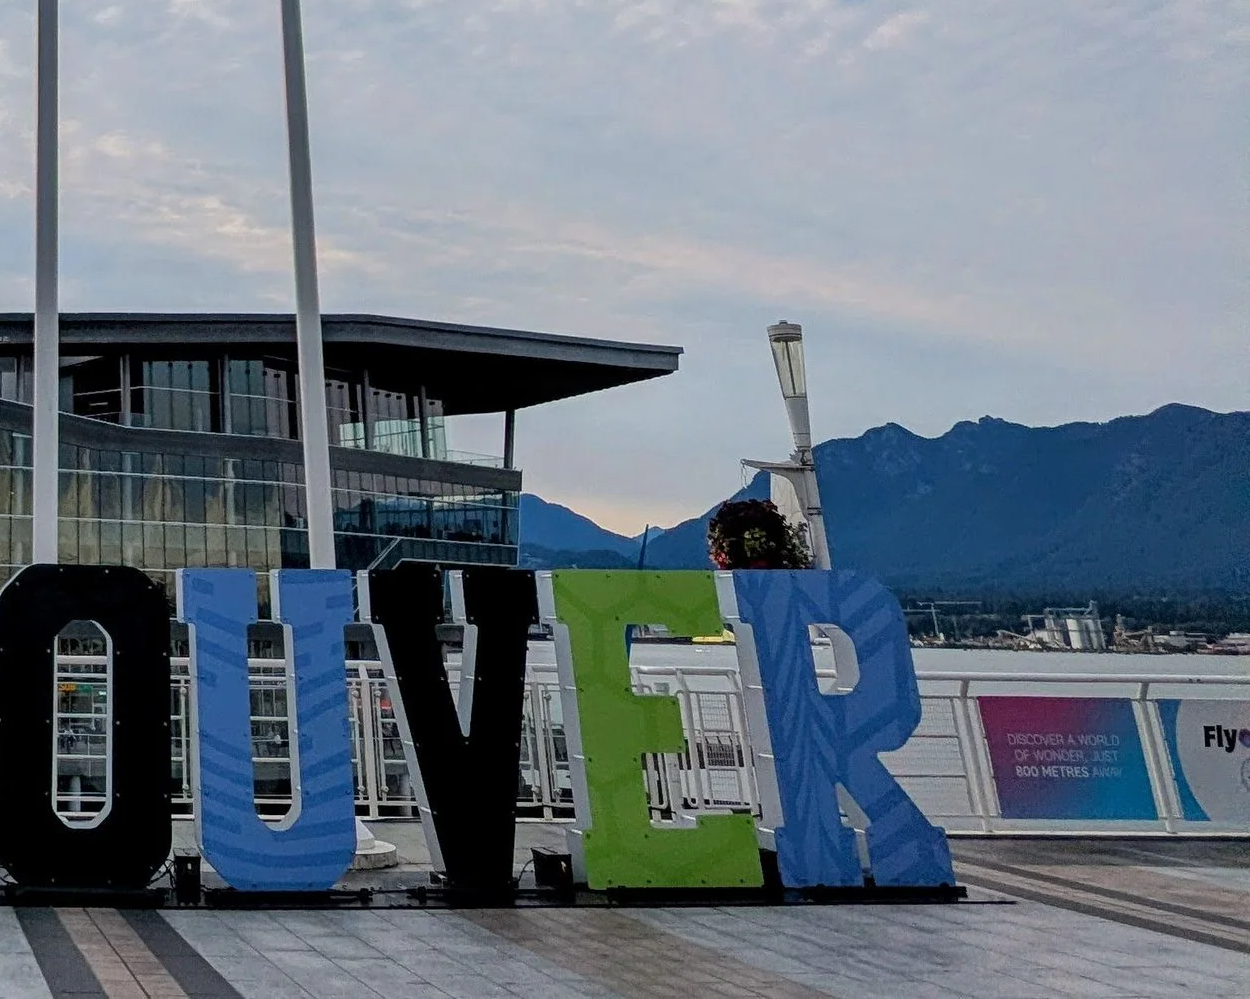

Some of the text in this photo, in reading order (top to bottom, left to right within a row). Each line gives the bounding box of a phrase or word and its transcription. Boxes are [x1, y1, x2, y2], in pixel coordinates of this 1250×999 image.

[1007, 732, 1121, 747] DISCOVER A WORLD
[1014, 749, 1030, 761] OF
[1092, 750, 1120, 762] JUST
[1015, 765, 1039, 778] 800
[1041, 765, 1090, 778] METRES
